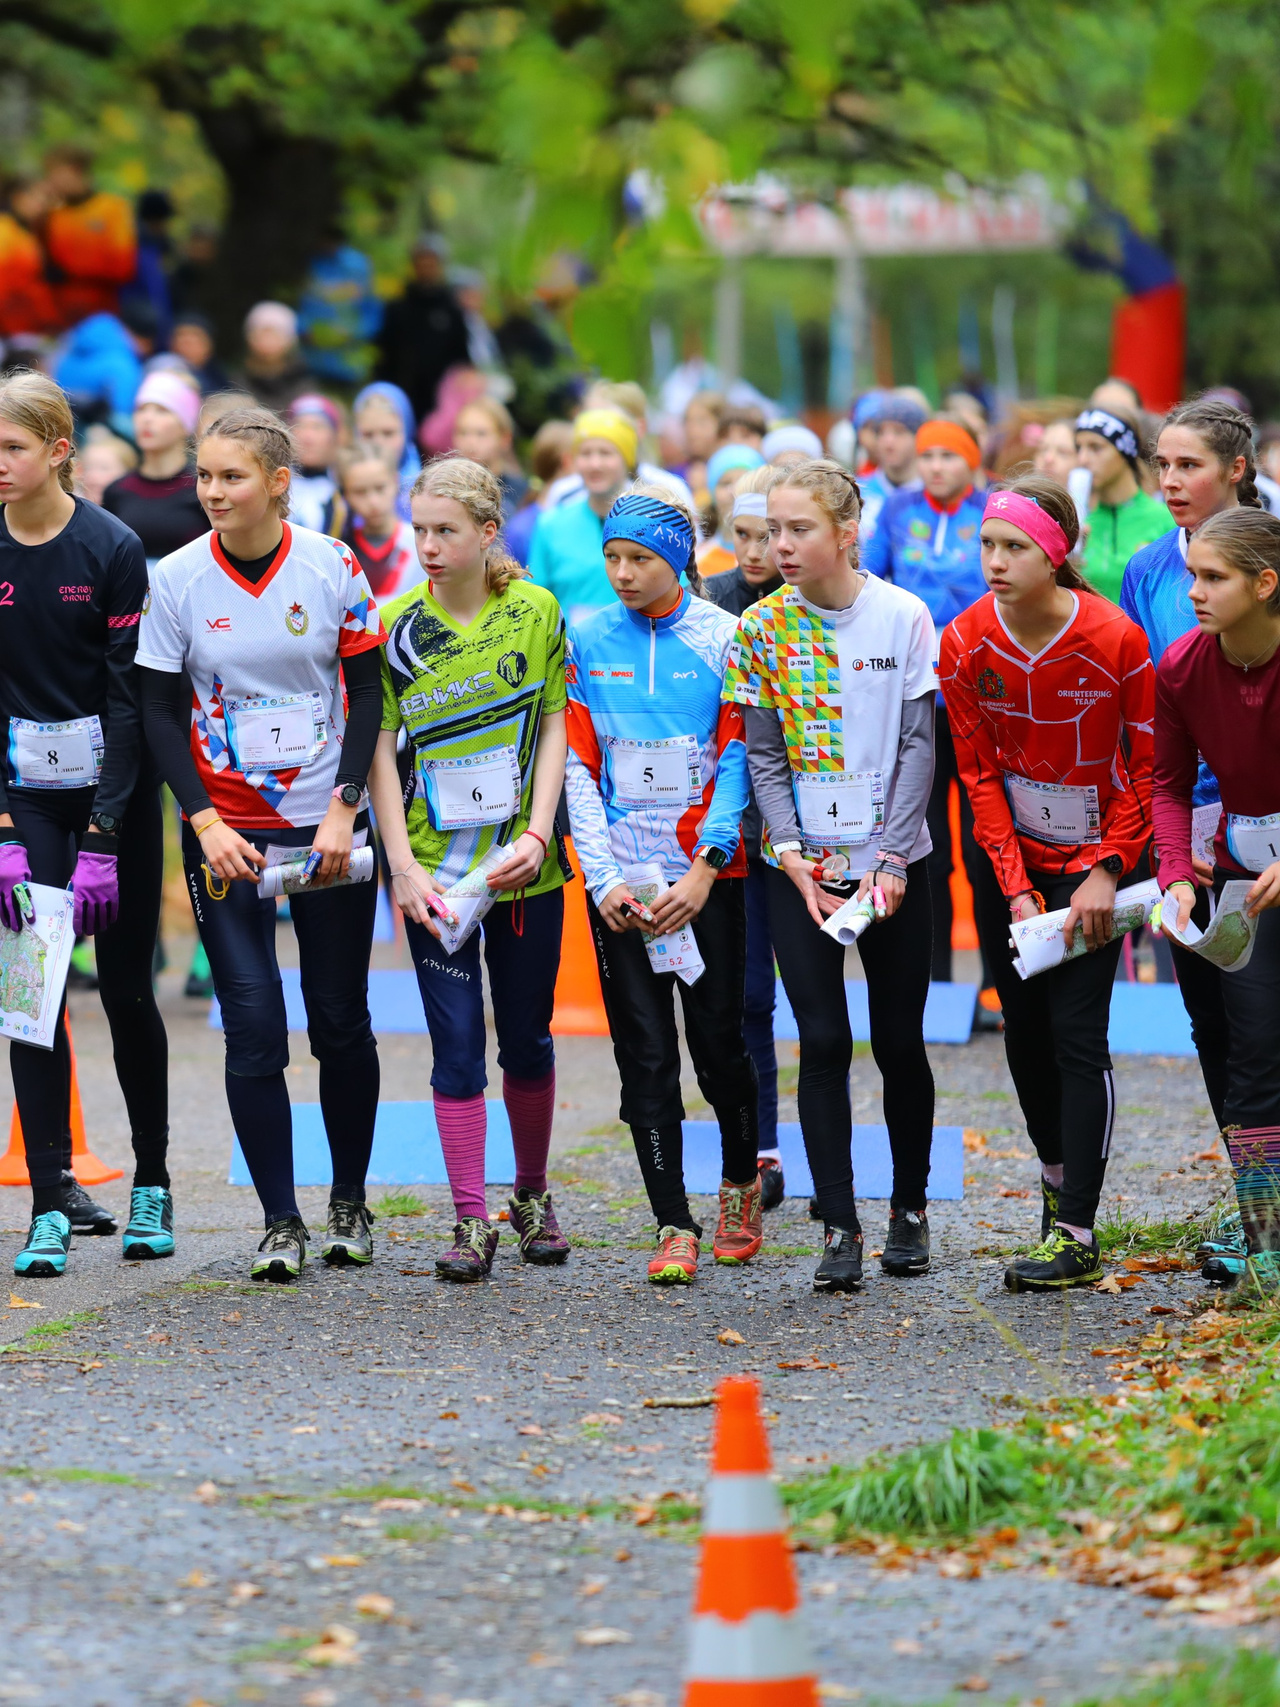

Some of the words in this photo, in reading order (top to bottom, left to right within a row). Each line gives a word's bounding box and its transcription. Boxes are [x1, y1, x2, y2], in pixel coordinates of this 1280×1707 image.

[62, 594, 91, 602] GROUP
[400, 670, 494, 717] ФЕНИКС
[1057, 689, 1113, 698] ORIENTEERING
[270, 727, 281, 744] 7
[47, 750, 58, 765] 8
[642, 767, 654, 783] 5
[472, 786, 483, 802] 6
[827, 802, 838, 818] 4
[1040, 806, 1051, 821] 3
[1267, 842, 1278, 868] 1
[669, 956, 683, 967] 5.2
